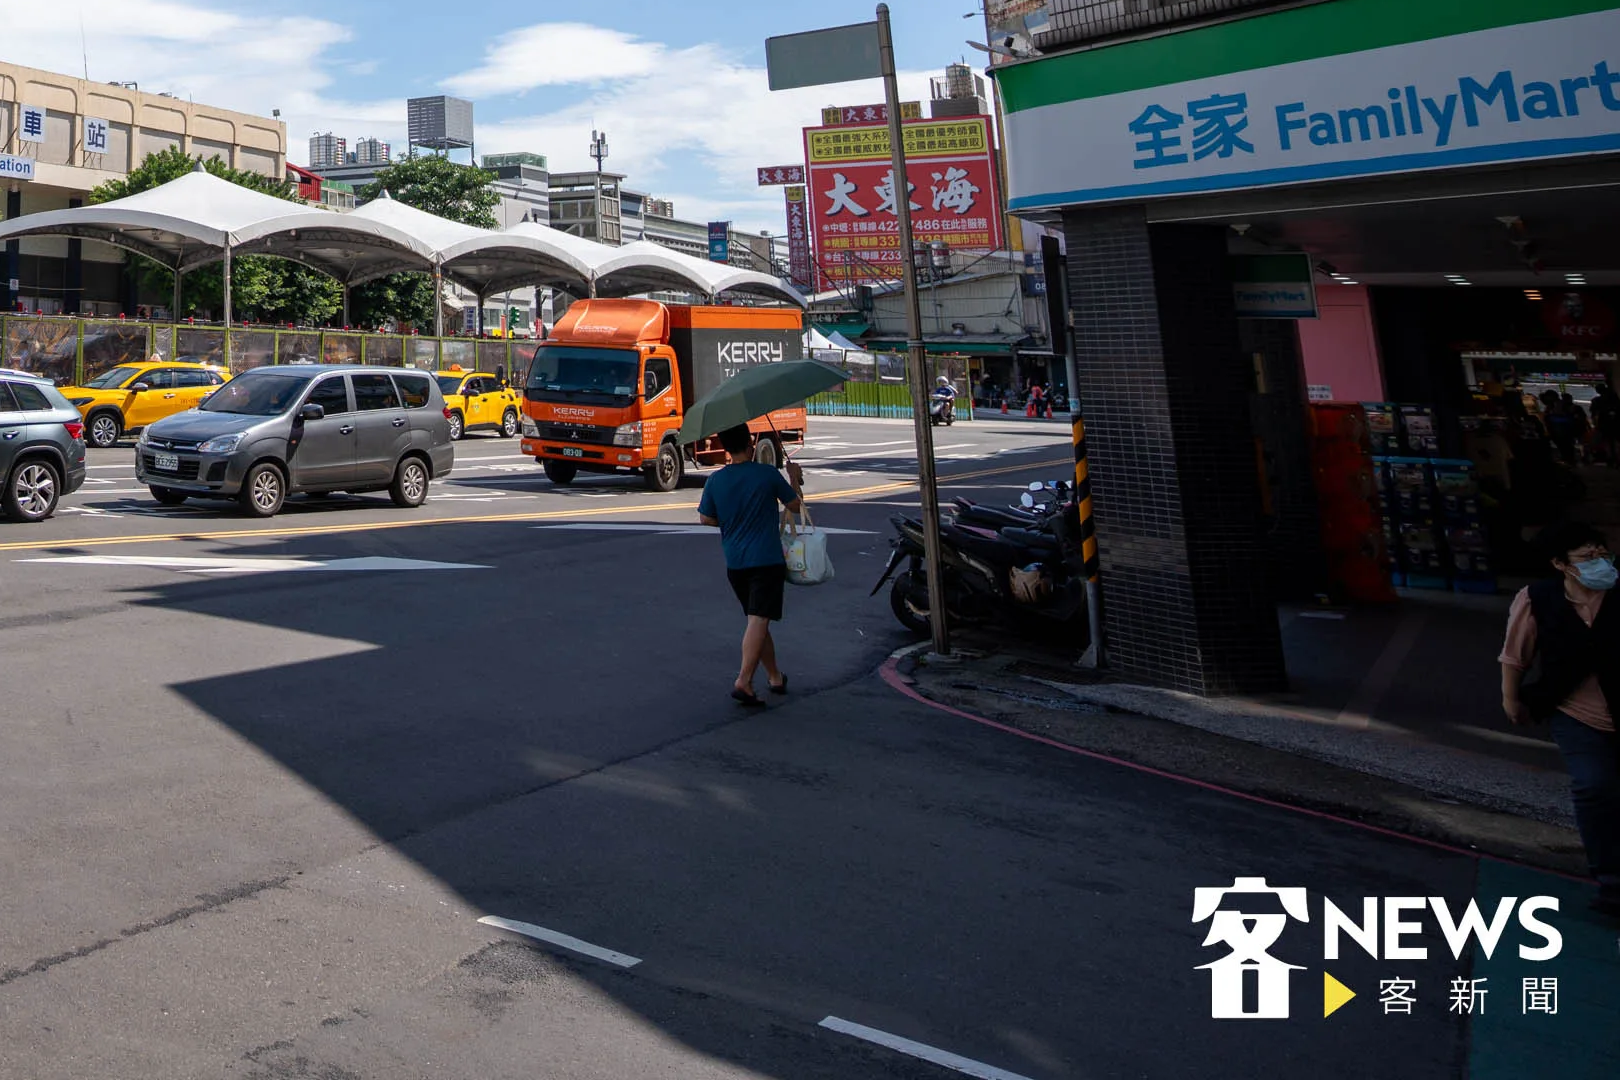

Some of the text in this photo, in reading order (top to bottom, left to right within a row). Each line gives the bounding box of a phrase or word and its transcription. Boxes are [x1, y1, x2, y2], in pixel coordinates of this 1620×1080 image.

[1128, 61, 1620, 169] 全家 FamilyMart
[759, 169, 801, 183] 大東海
[1561, 325, 1601, 336] KFC
[718, 342, 783, 363] KERRY
[553, 407, 595, 417] KERRY
